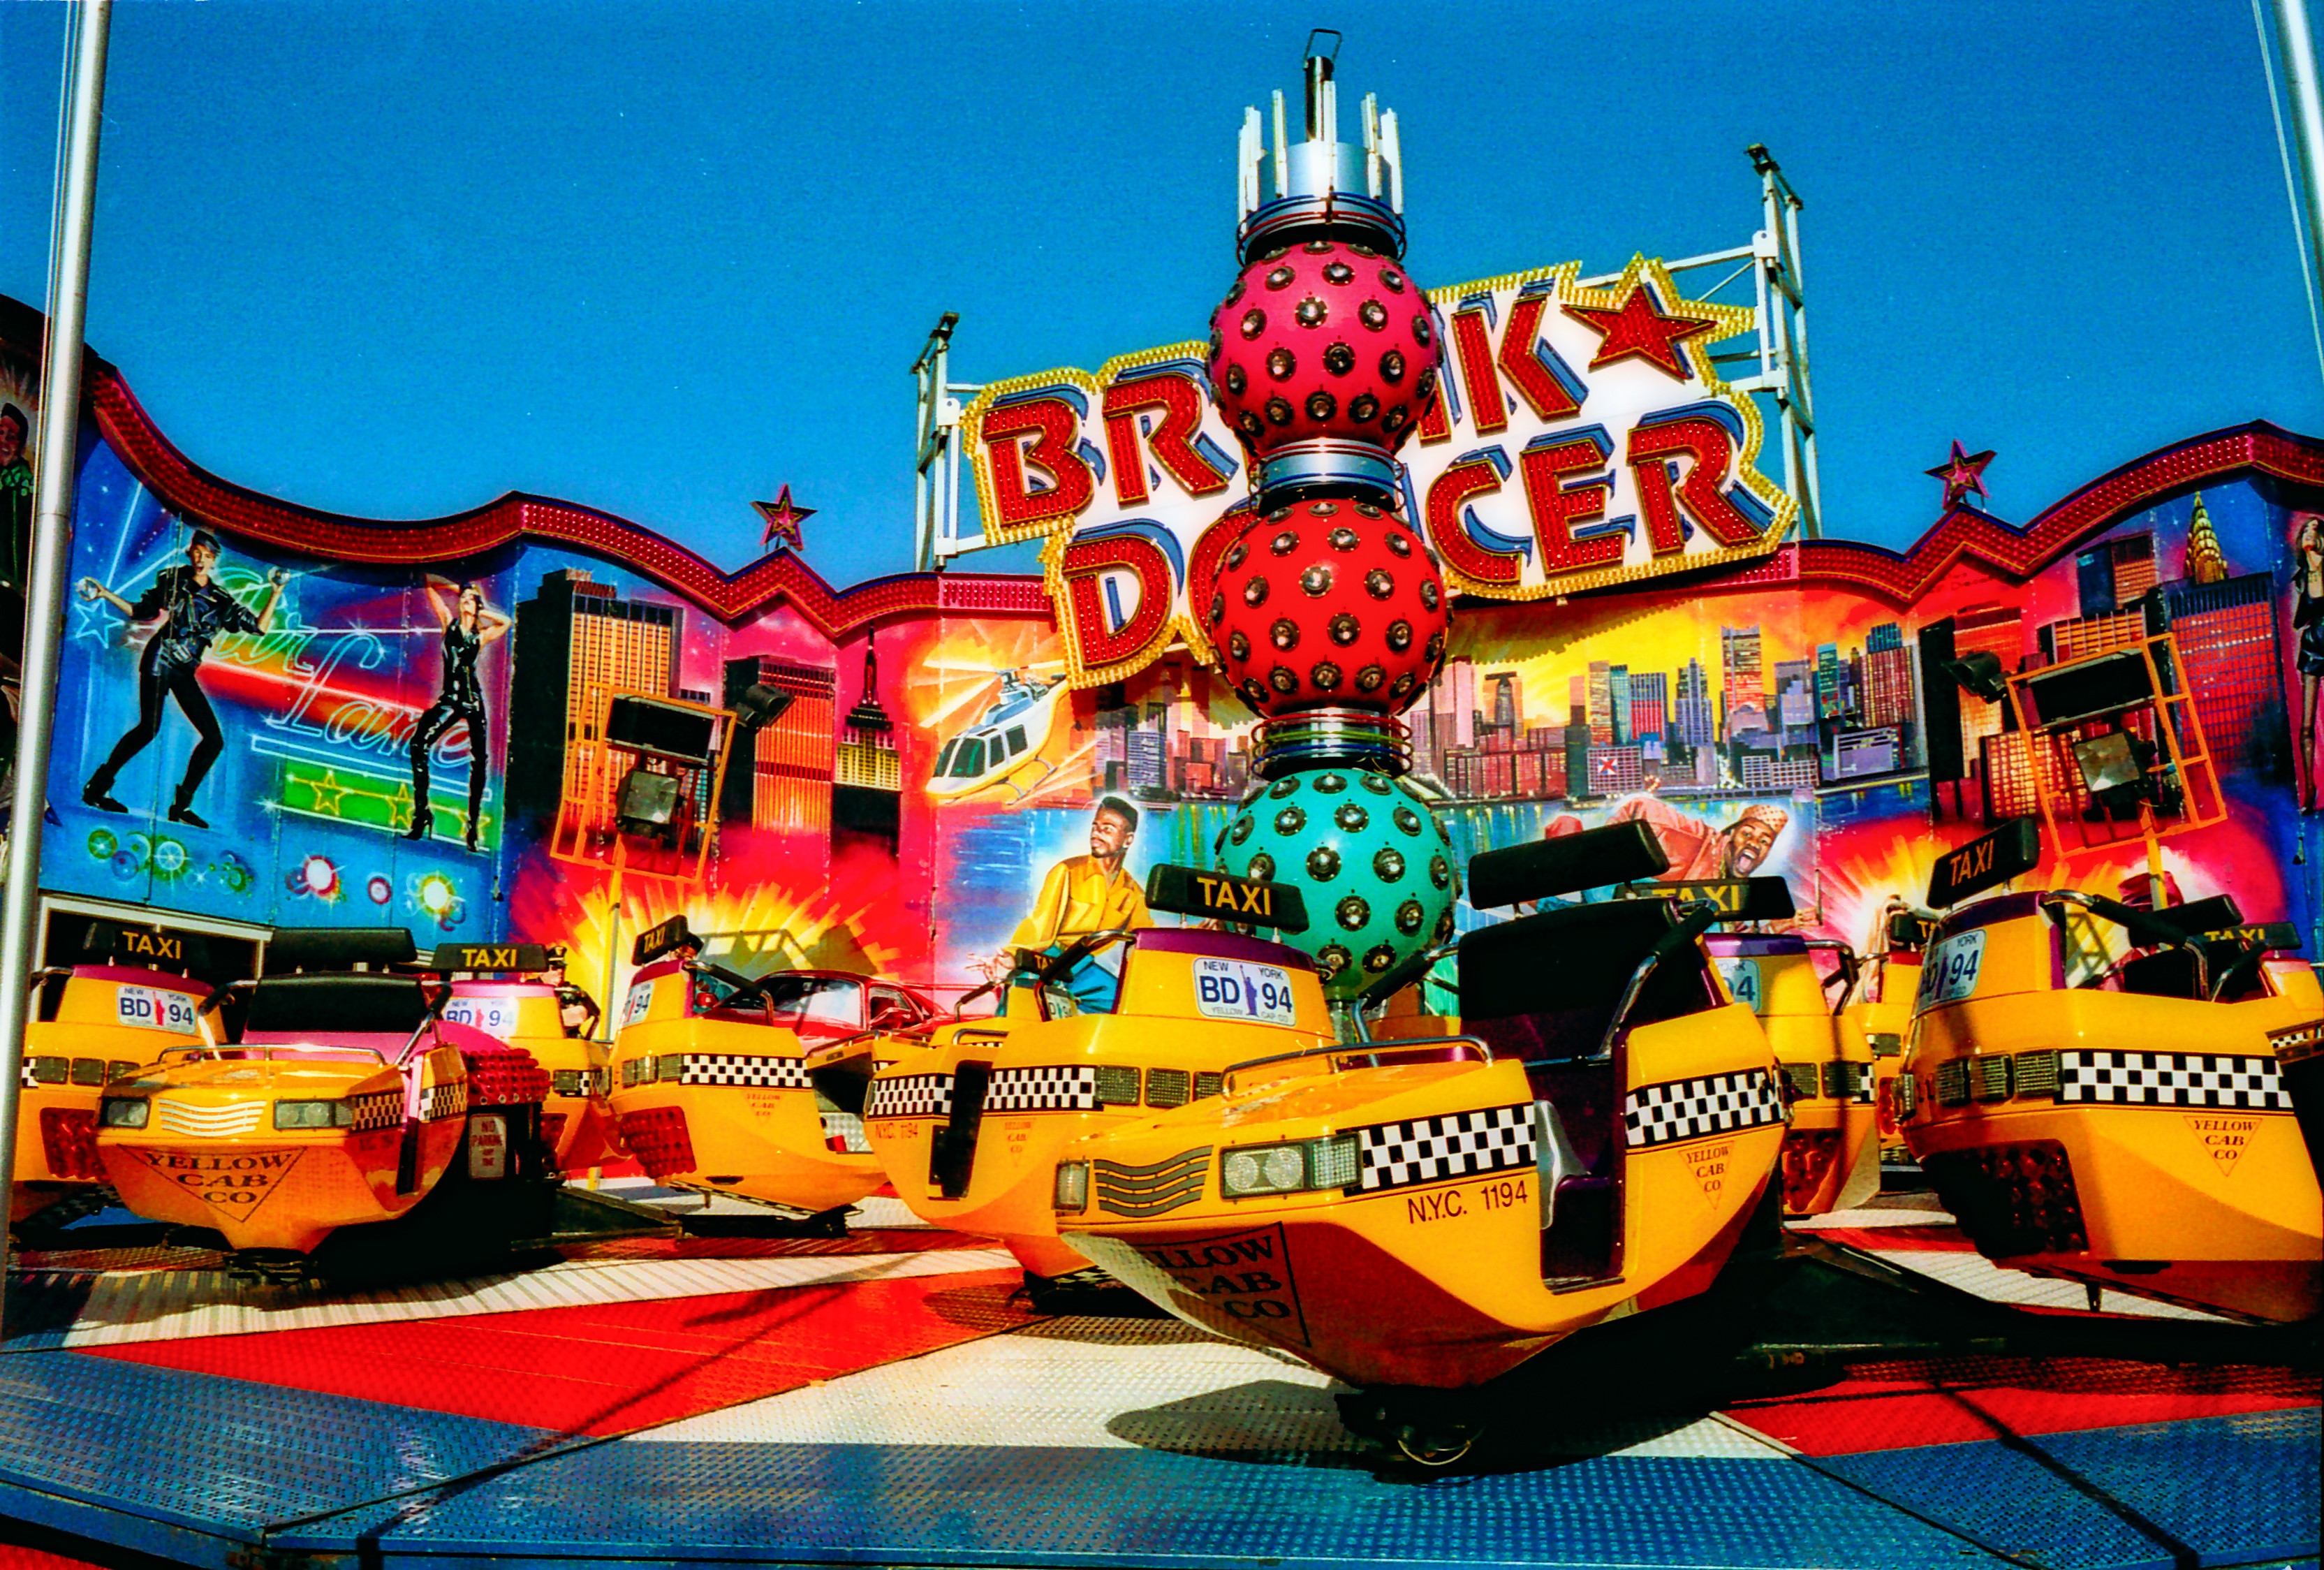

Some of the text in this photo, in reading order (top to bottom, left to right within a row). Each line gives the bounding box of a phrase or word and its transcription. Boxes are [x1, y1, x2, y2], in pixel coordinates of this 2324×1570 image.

[981, 281, 1585, 527] BRK
[1063, 400, 1777, 668] DCER
[1950, 839, 1994, 886] TAXI
[1197, 876, 1271, 916] TAXI
[122, 930, 182, 960] TAXI
[644, 926, 665, 954] TAXI
[462, 948, 517, 967] TAXI
[1034, 955, 1053, 970] TA
[1204, 961, 1284, 980] NEW YORK
[1949, 950, 1979, 985] 94
[1200, 976, 1293, 1013] BD 94
[120, 997, 151, 1017] BD
[168, 1004, 193, 1025] 94
[2194, 1120, 2256, 1131] YELLOW
[2205, 1134, 2244, 1145] CAB
[144, 1152, 293, 1171] YELLOW
[1686, 1146, 1728, 1164] YELLOW
[2214, 1149, 2237, 1159] CO
[177, 1173, 269, 1187] CAB
[1696, 1163, 1724, 1178] CAB
[1705, 1180, 1721, 1192] CO
[204, 1191, 257, 1204] CO
[1408, 1180, 1528, 1224] N.Y.C. 1194
[1140, 1235, 1273, 1268] LLOW
[1223, 1299, 1290, 1319] CO
